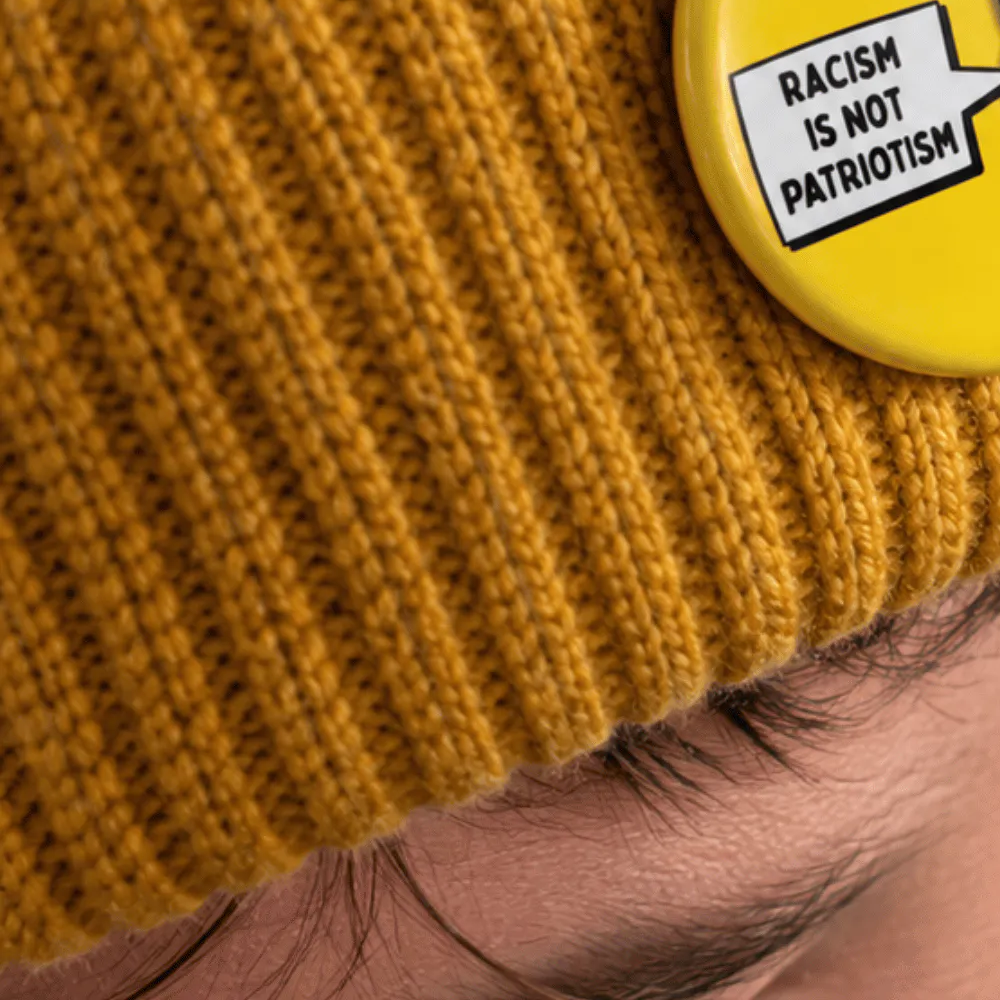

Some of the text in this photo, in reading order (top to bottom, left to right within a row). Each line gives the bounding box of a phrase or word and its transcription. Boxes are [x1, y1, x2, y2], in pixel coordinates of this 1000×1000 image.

[778, 35, 902, 107] RACISM
[803, 86, 904, 152] IS NOT
[779, 120, 960, 216] PATRIOTISM
